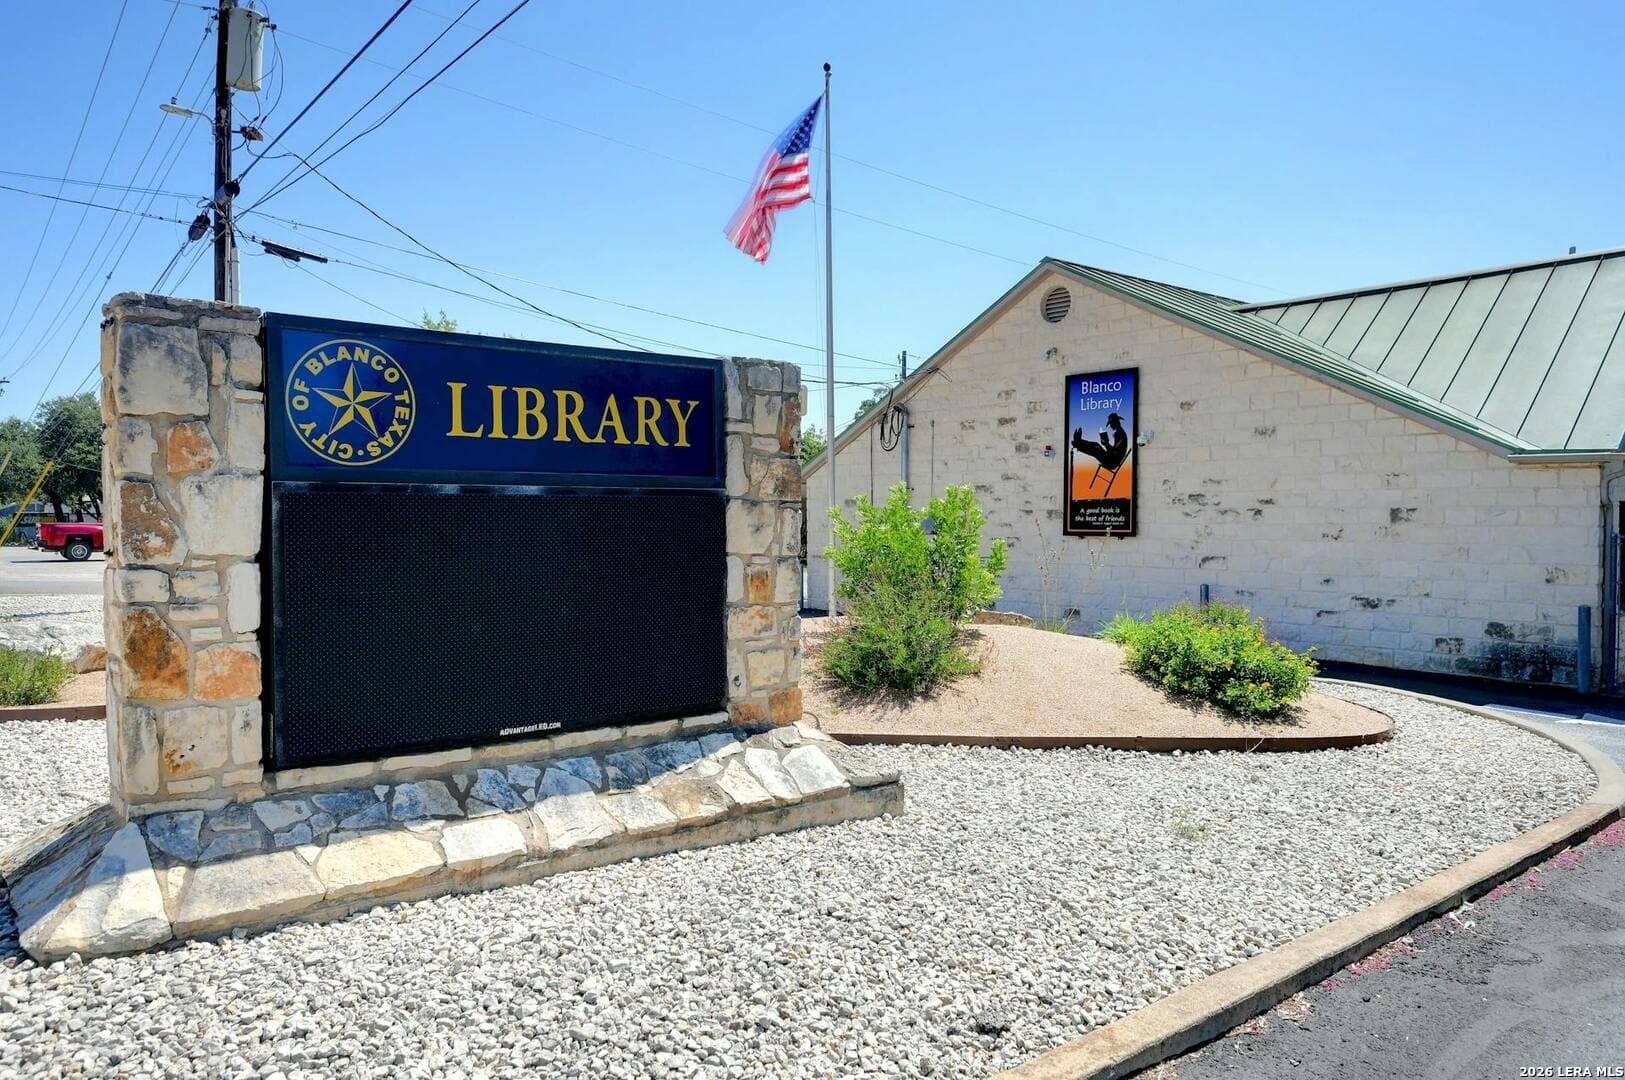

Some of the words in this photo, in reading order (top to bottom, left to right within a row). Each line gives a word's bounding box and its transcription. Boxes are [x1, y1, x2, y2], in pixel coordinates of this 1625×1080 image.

[304, 346, 400, 383] BLANCO
[292, 378, 310, 411] OF
[1080, 397, 1122, 411] Library
[1081, 380, 1122, 395] Blanco
[366, 390, 410, 457] TEXAS
[446, 381, 700, 447] LIBRARY
[298, 422, 353, 459] CITY
[1086, 507, 1100, 515] good
